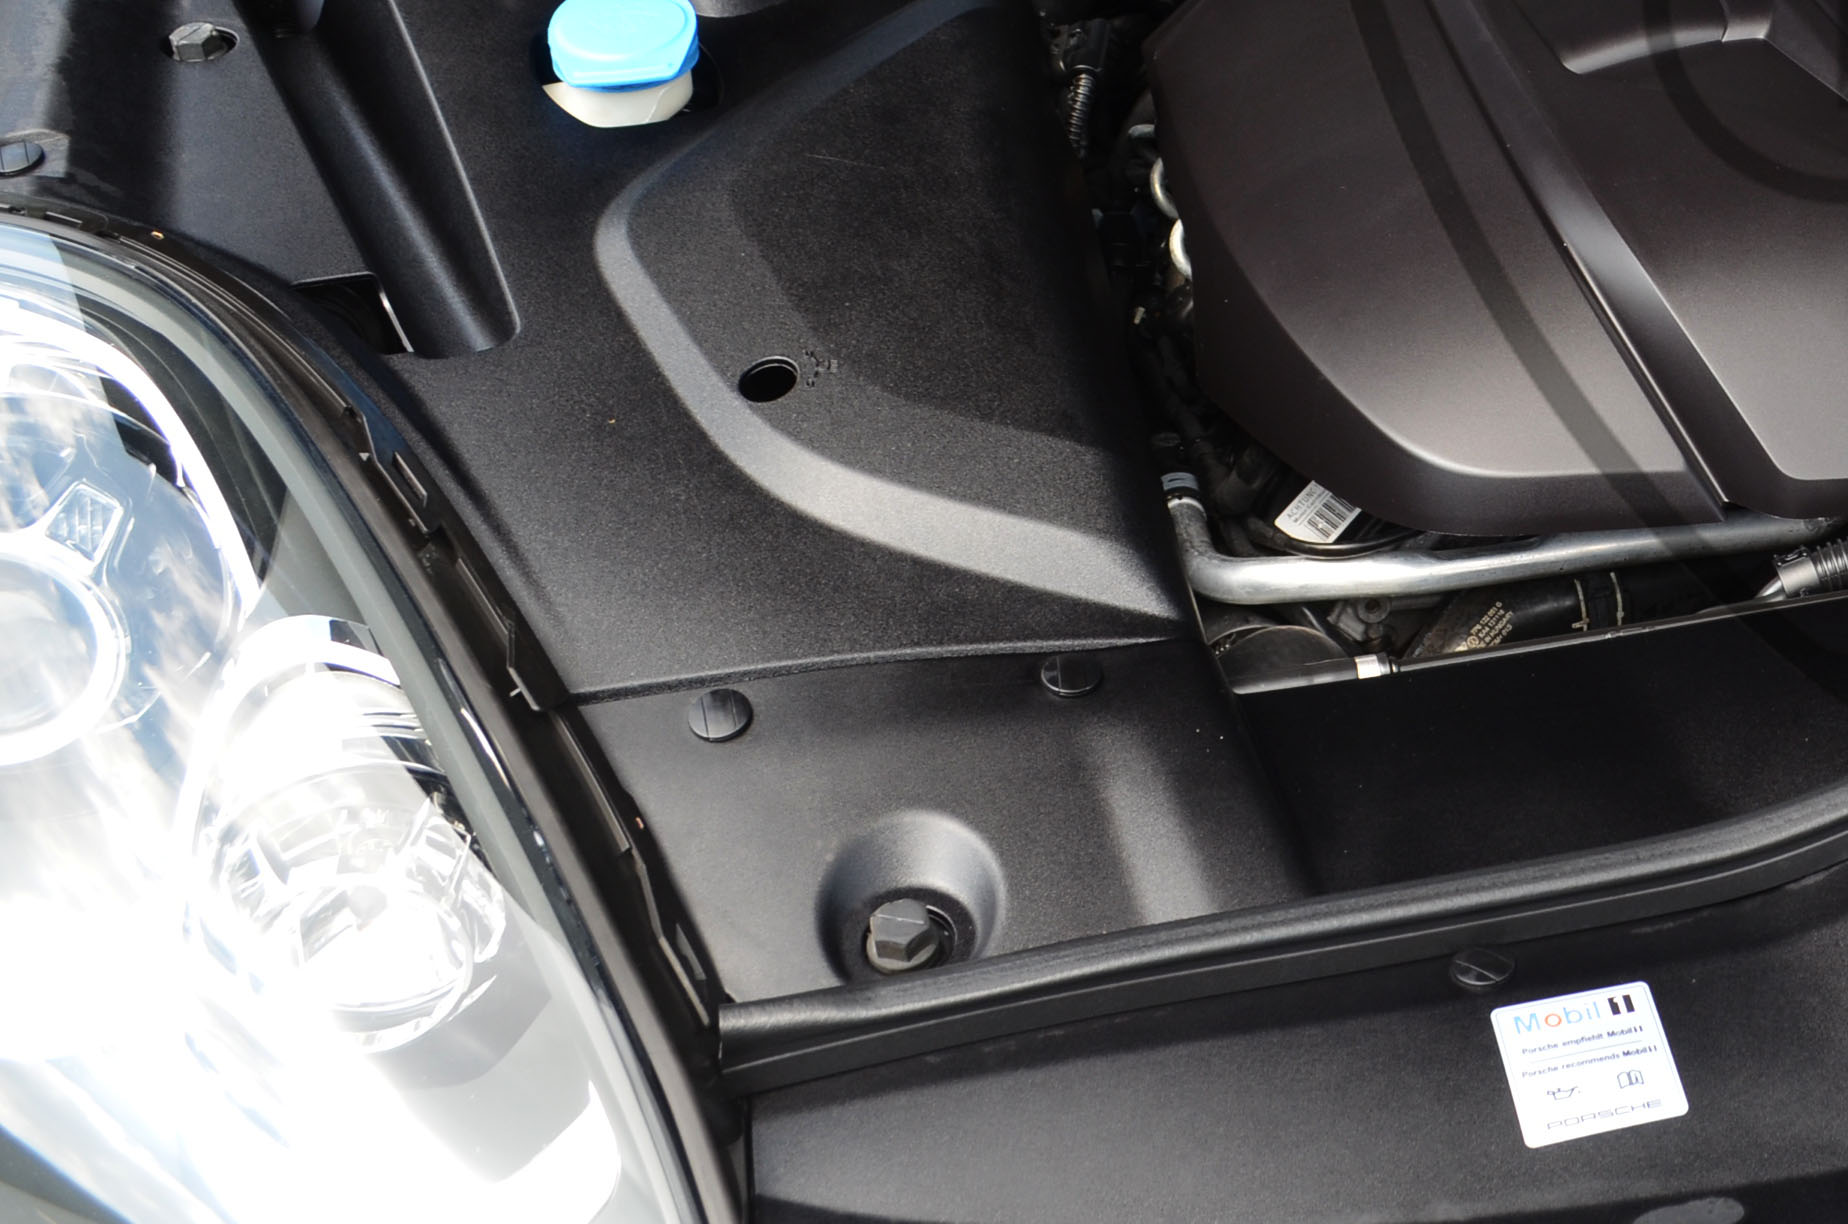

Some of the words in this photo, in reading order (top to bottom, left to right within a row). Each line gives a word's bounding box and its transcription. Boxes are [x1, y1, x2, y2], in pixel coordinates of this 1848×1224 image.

[1513, 1001, 1601, 1035] Mobil
[1522, 1041, 1559, 1054] Porsche
[1562, 1033, 1604, 1047] empfiehlt
[1522, 1065, 1559, 1078] Porsche
[1562, 1053, 1620, 1071] recommends
[1546, 1099, 1663, 1130] PORSCHE
